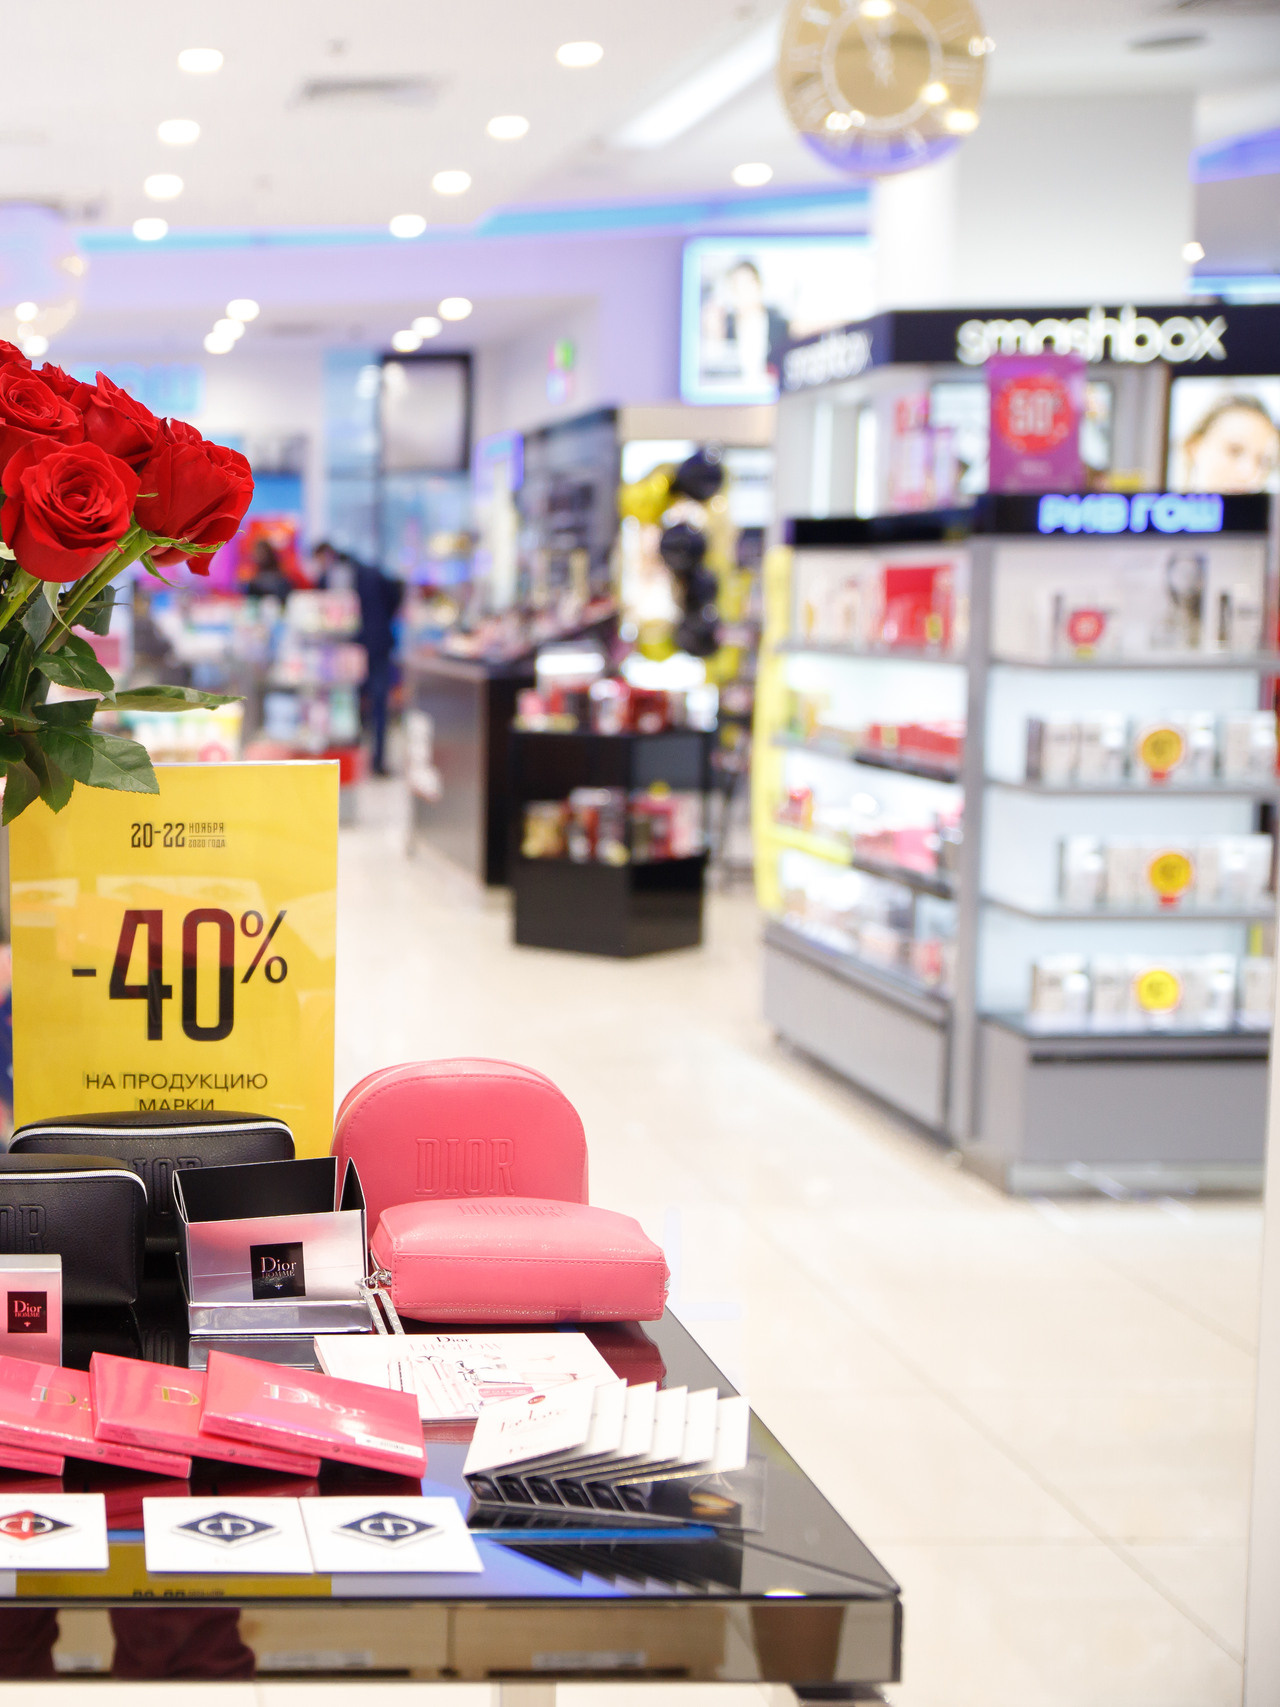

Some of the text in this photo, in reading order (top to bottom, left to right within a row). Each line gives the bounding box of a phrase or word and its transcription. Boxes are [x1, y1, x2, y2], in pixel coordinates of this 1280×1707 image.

[956, 304, 1228, 366] smashbox
[131, 822, 225, 849] 20-22 НОЯБРЯ
[188, 838, 227, 849] 2020 ГОДА
[72, 908, 288, 1042] -40%
[86, 1073, 268, 1093] НА ПРОДУКЦИЮ
[138, 1098, 215, 1112] МАРКИ
[414, 1137, 517, 1198] DIOR
[261, 1256, 297, 1274] Dior
[14, 1300, 42, 1314] Dior
[262, 1381, 367, 1418] Dior
